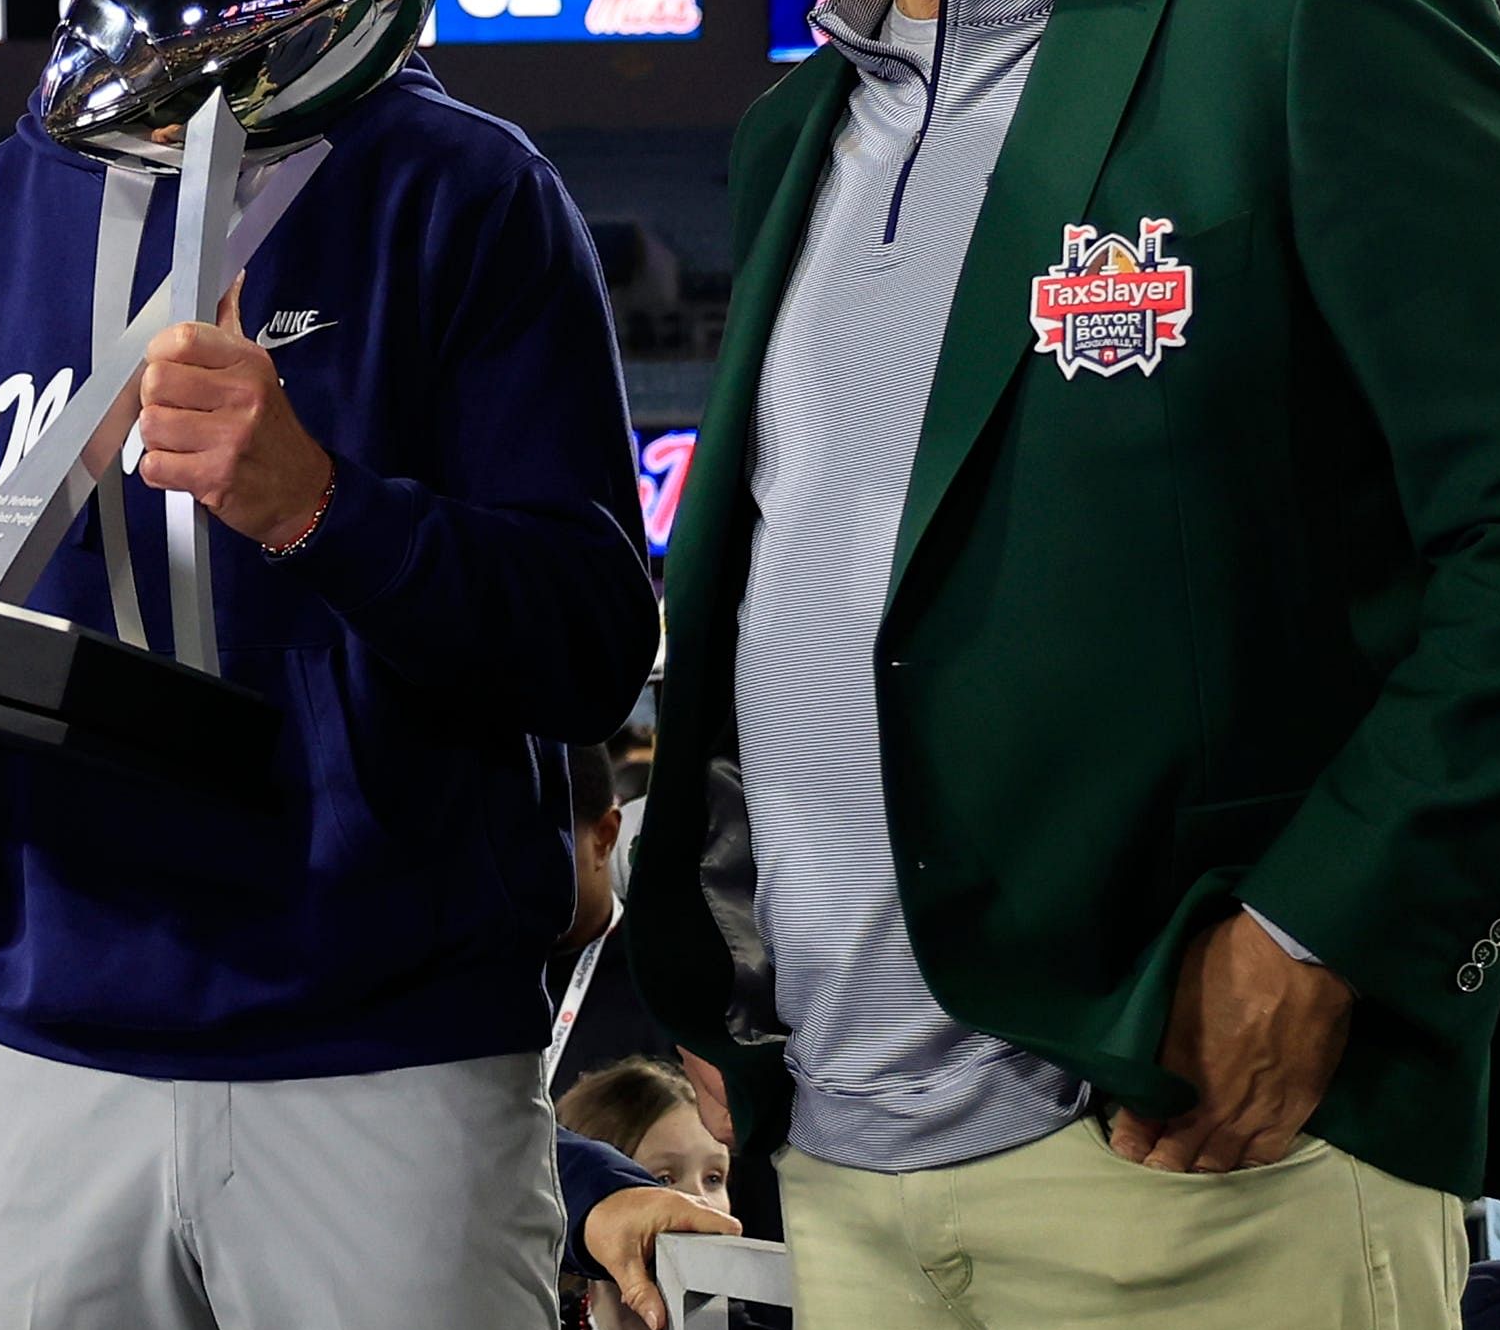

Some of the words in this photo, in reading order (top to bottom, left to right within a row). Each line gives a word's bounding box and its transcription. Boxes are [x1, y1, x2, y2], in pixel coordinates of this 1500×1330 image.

[1043, 277, 1178, 307] TaxSlayer
[270, 310, 319, 333] NIKE
[1075, 313, 1142, 327] GATOR
[1076, 326, 1143, 342] BOWL
